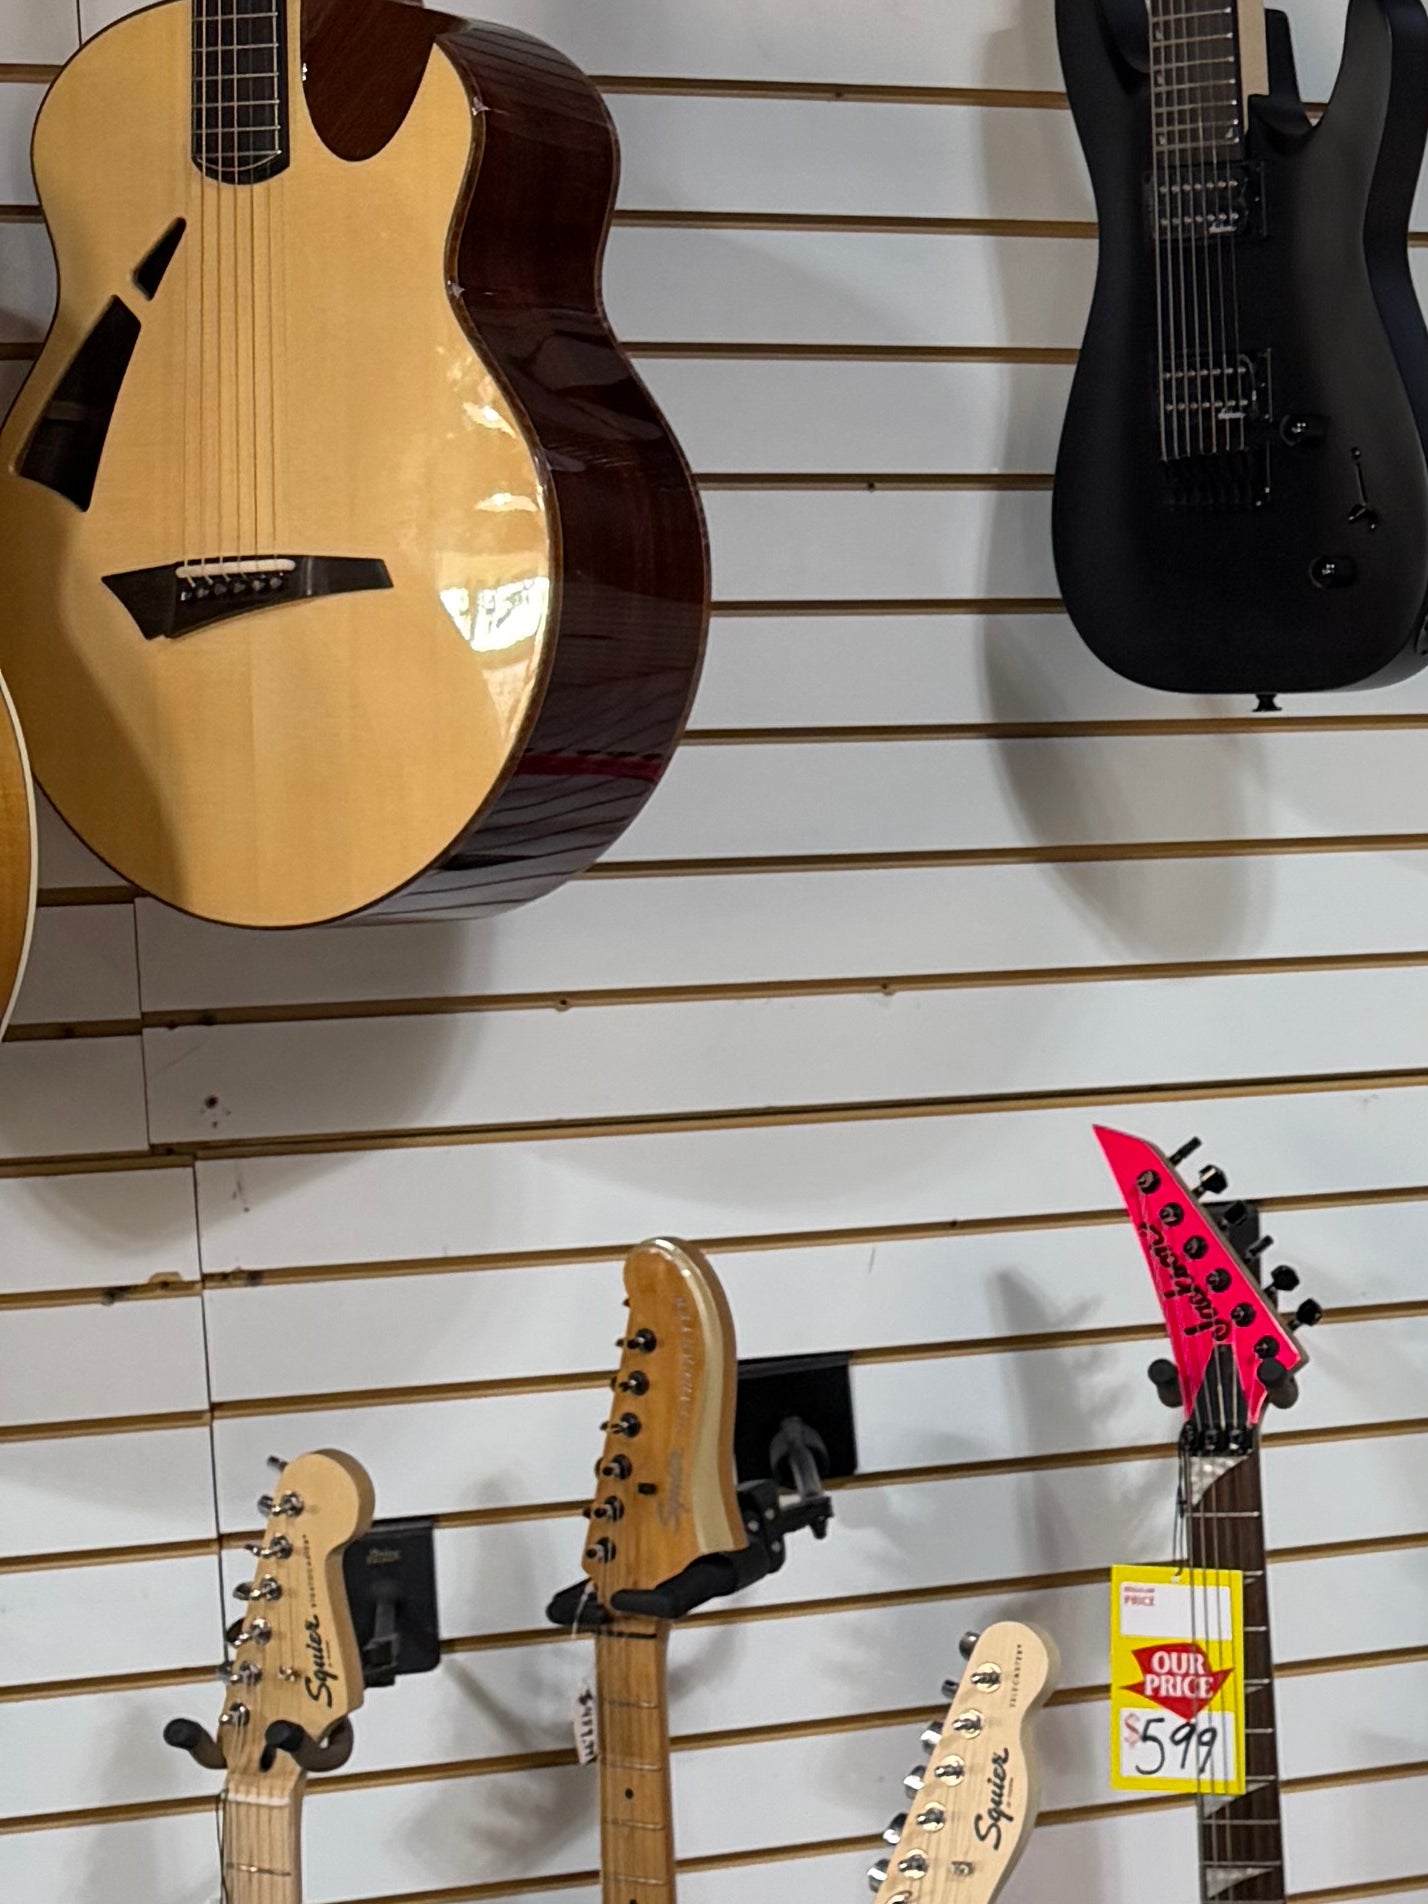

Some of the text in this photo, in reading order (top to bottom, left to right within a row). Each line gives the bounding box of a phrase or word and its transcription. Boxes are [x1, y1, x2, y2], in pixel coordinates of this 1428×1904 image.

[305, 1613, 339, 1709] Squier
[1144, 1675, 1213, 1698] PRICE
[1152, 1651, 1205, 1674] OUR
[1124, 1713, 1217, 1775] $599
[975, 1747, 1009, 1850] Squier
